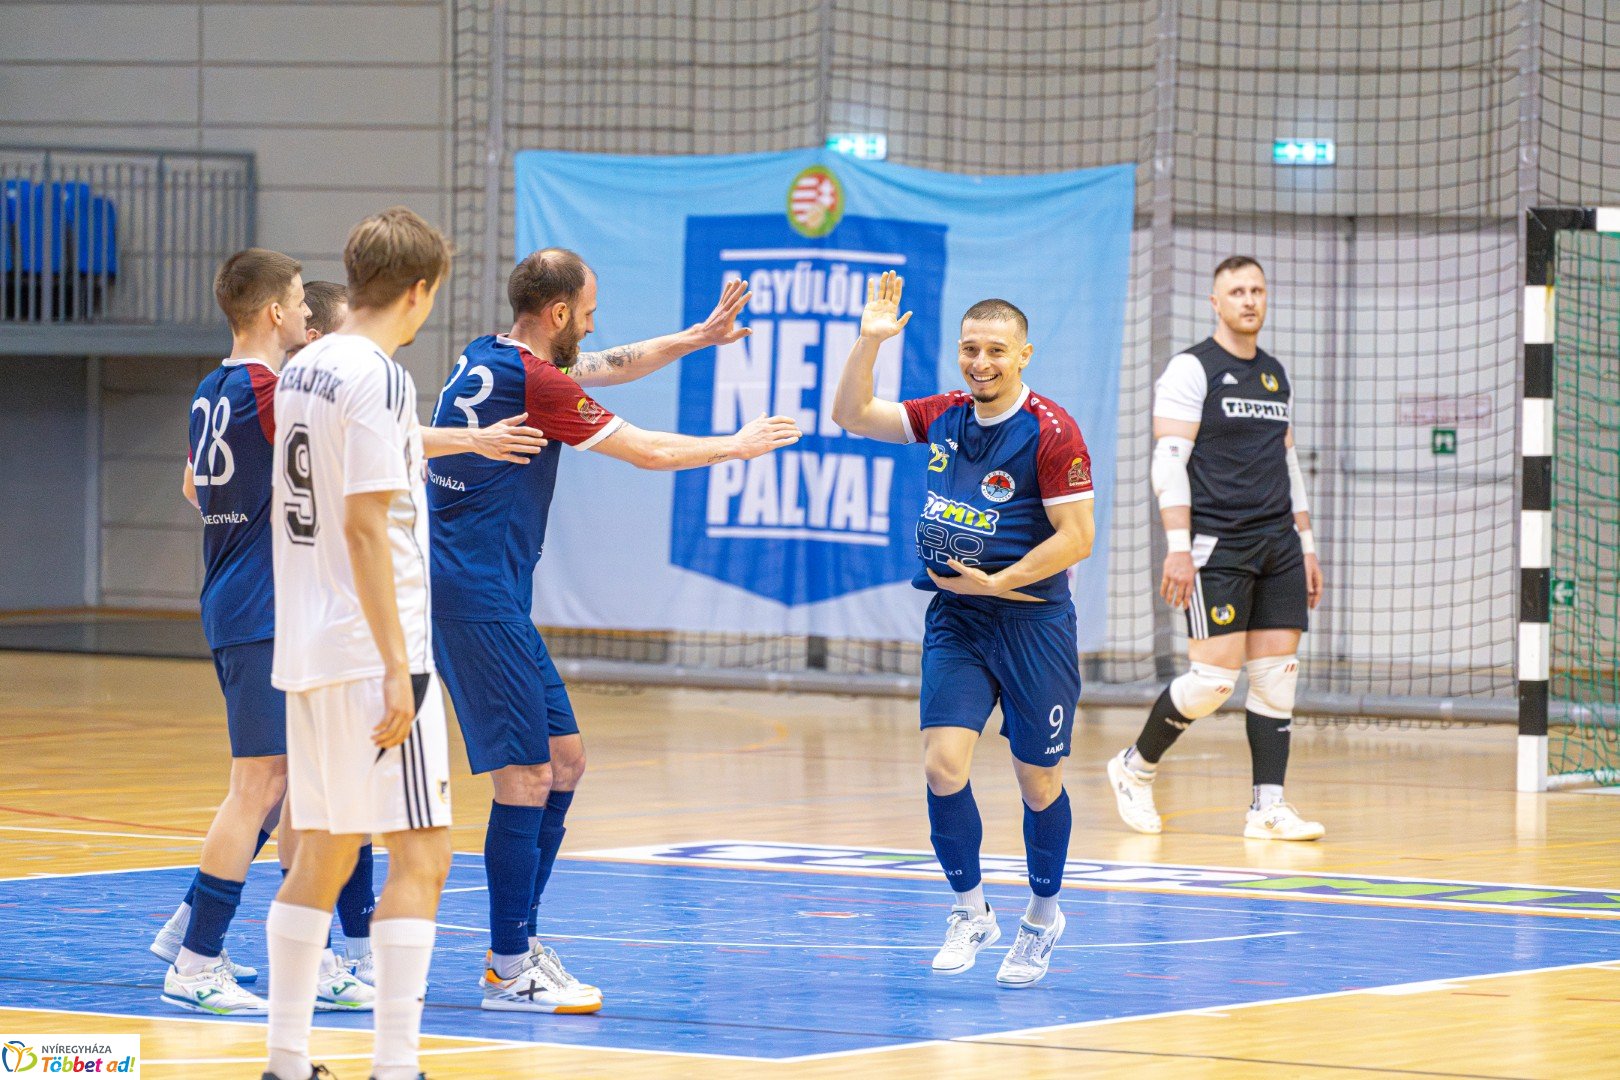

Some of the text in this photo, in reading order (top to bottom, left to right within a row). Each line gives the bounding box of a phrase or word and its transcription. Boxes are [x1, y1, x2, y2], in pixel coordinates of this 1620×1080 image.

[191, 396, 235, 487] 28
[283, 423, 320, 546] 9
[1044, 742, 1064, 755] JAKO
[1049, 704, 1064, 739] 9
